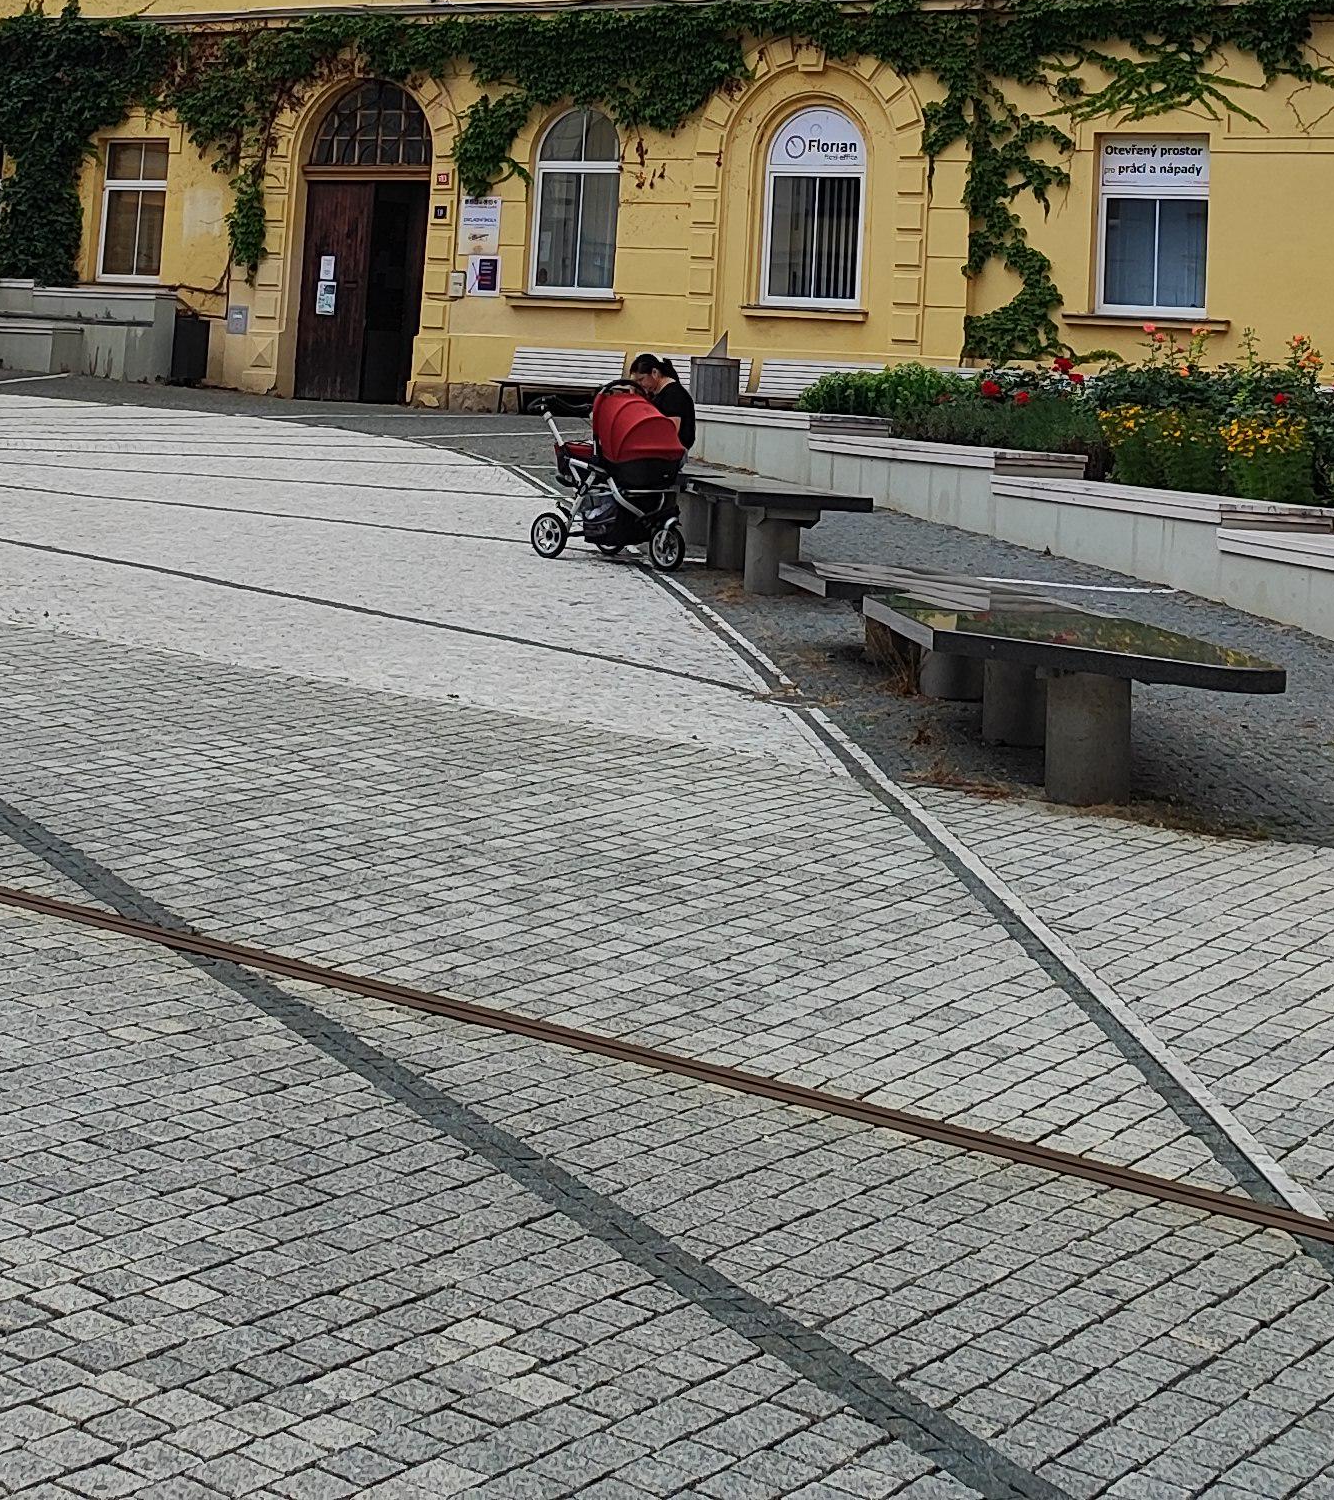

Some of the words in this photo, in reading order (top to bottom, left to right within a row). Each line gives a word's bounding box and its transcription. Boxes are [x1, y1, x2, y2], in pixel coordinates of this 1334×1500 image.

[808, 138, 857, 153] Florian
[1104, 144, 1157, 158] Otevřený
[1160, 146, 1203, 158] prostor
[1118, 162, 1146, 176] práci
[1149, 165, 1156, 174] a
[1159, 162, 1203, 177] nápady
